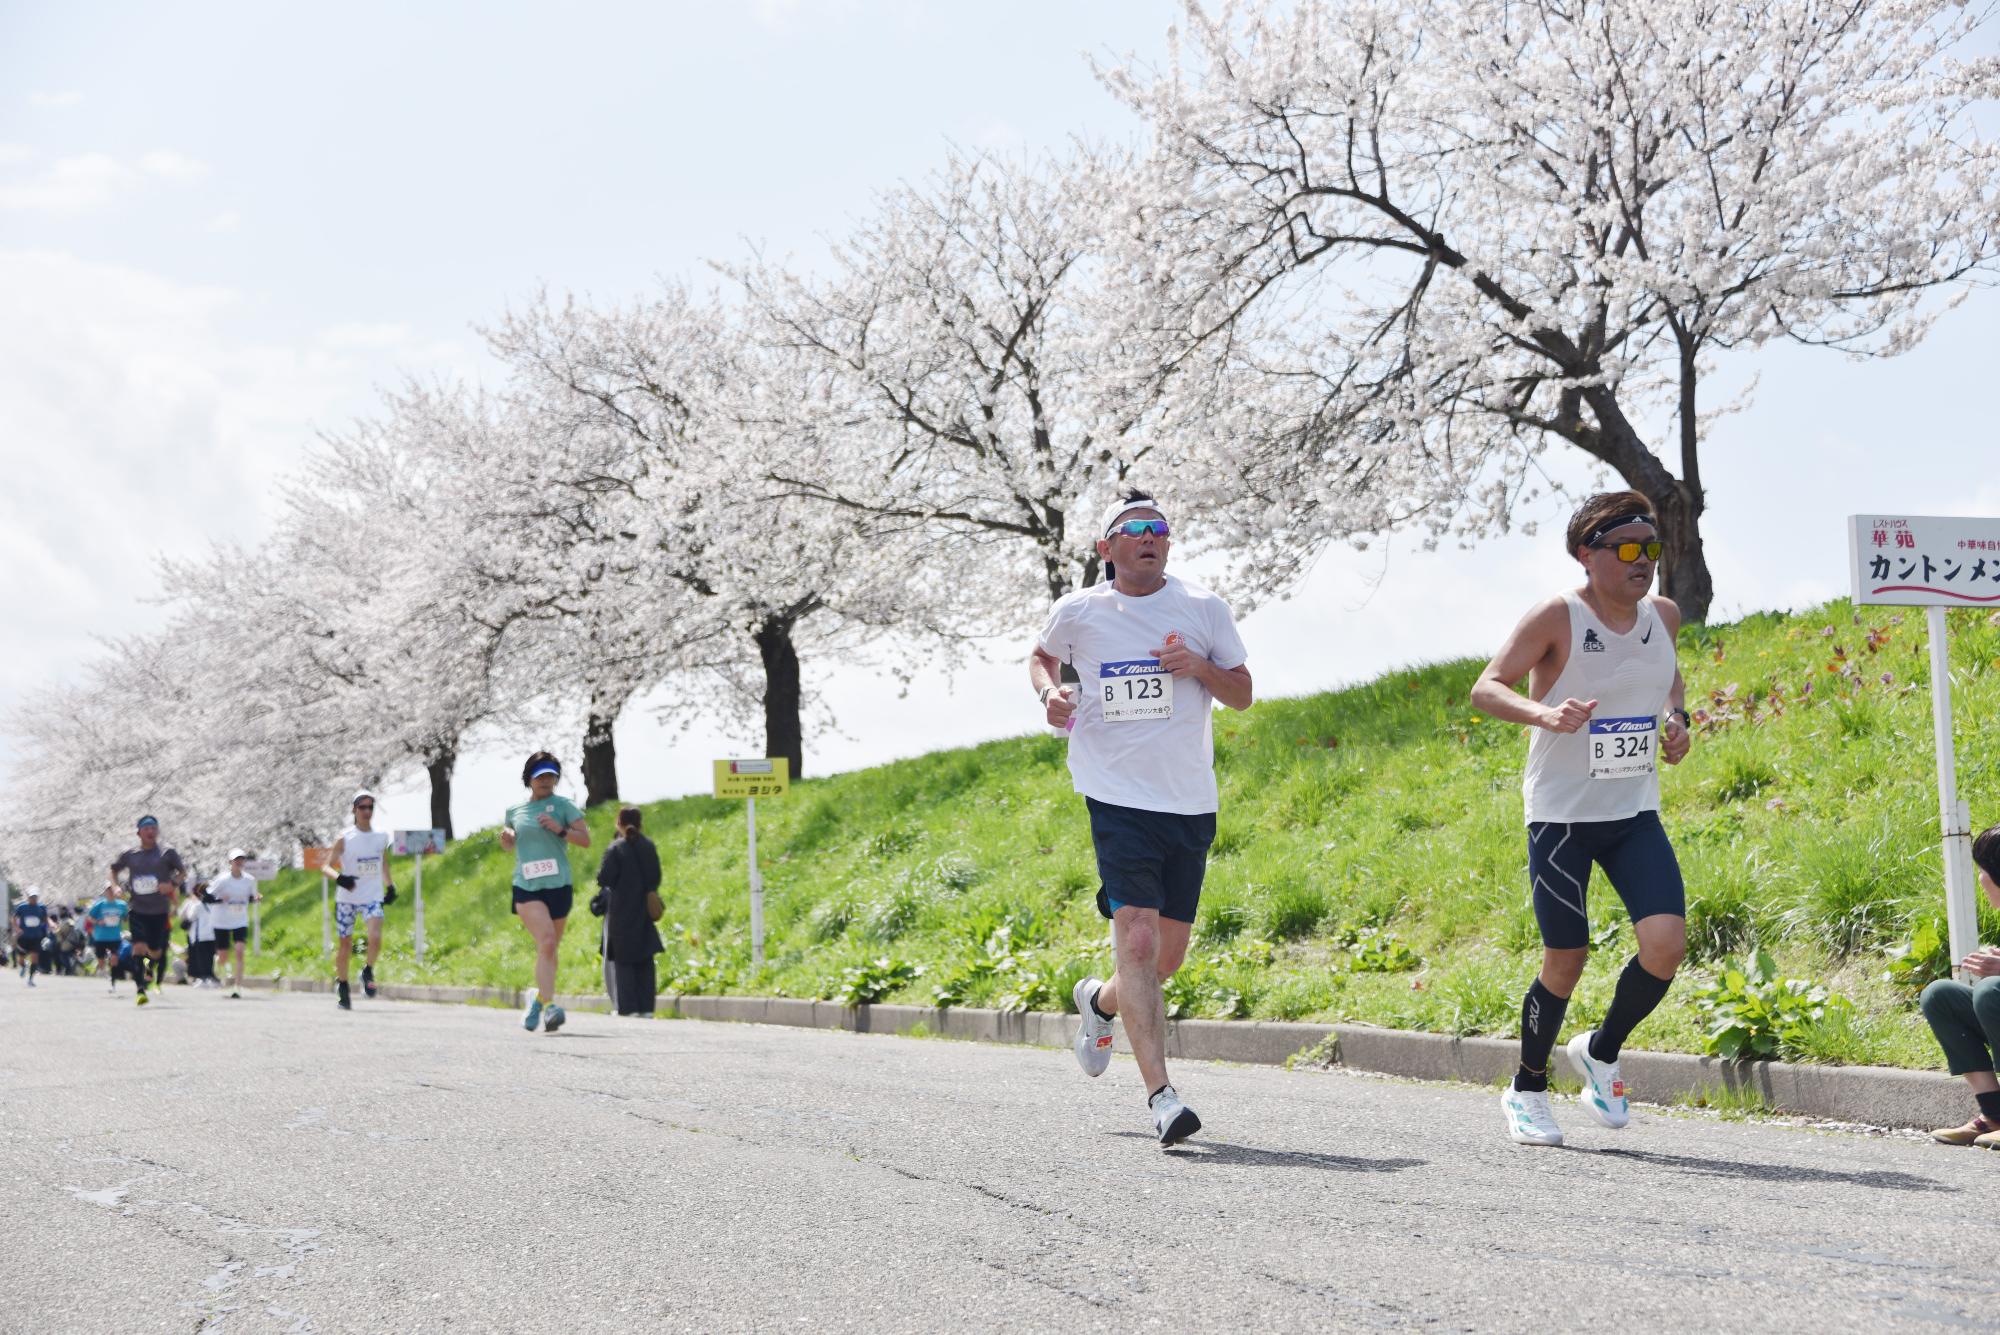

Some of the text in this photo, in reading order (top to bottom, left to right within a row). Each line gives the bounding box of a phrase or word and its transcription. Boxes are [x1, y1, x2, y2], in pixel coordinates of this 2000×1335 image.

[1873, 520, 1909, 528] レストハウス
[1105, 678, 1163, 702] B 123
[1595, 735, 1649, 759] B 324
[533, 862, 553, 874] 339
[1529, 996, 1540, 1036] 2XU
